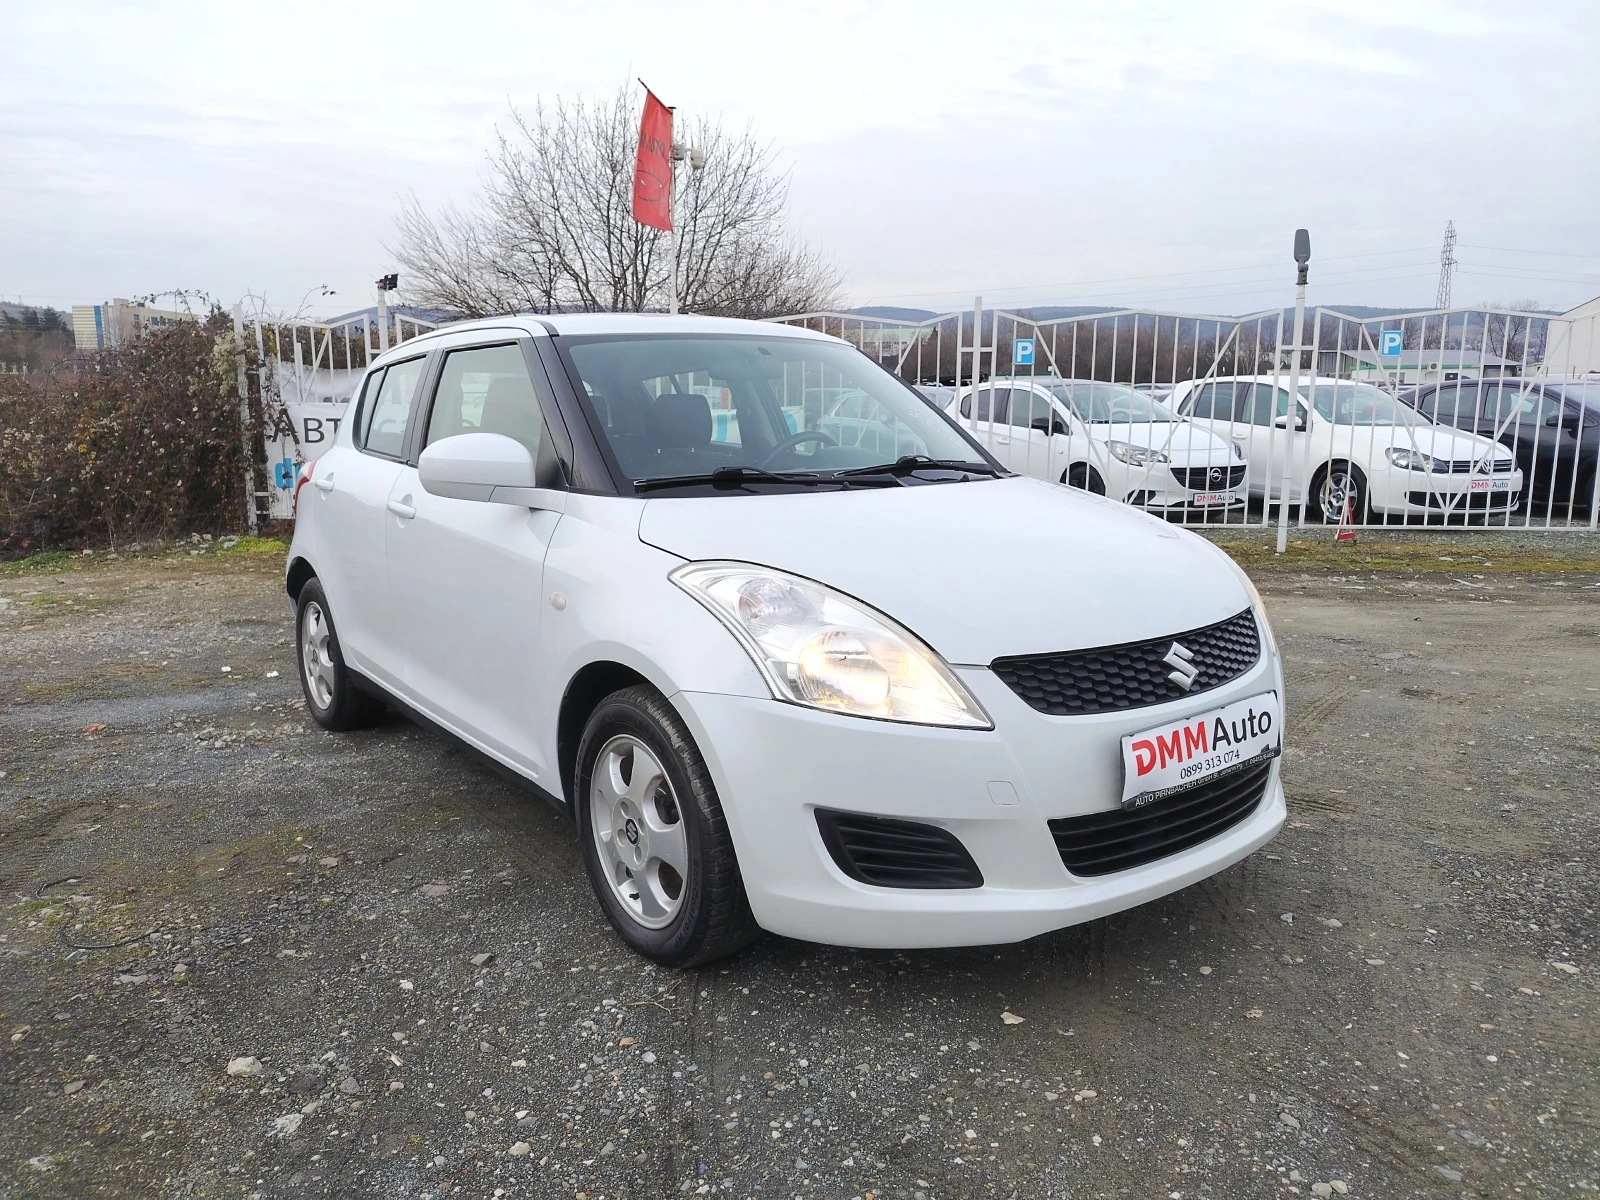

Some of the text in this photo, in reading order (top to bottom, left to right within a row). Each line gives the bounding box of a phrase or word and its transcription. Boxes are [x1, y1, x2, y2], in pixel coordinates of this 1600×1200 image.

[1016, 342, 1033, 362] P
[1383, 333, 1401, 354] P
[1180, 749, 1240, 780] 0899 313 074
[1135, 793, 1154, 807] AUTO
